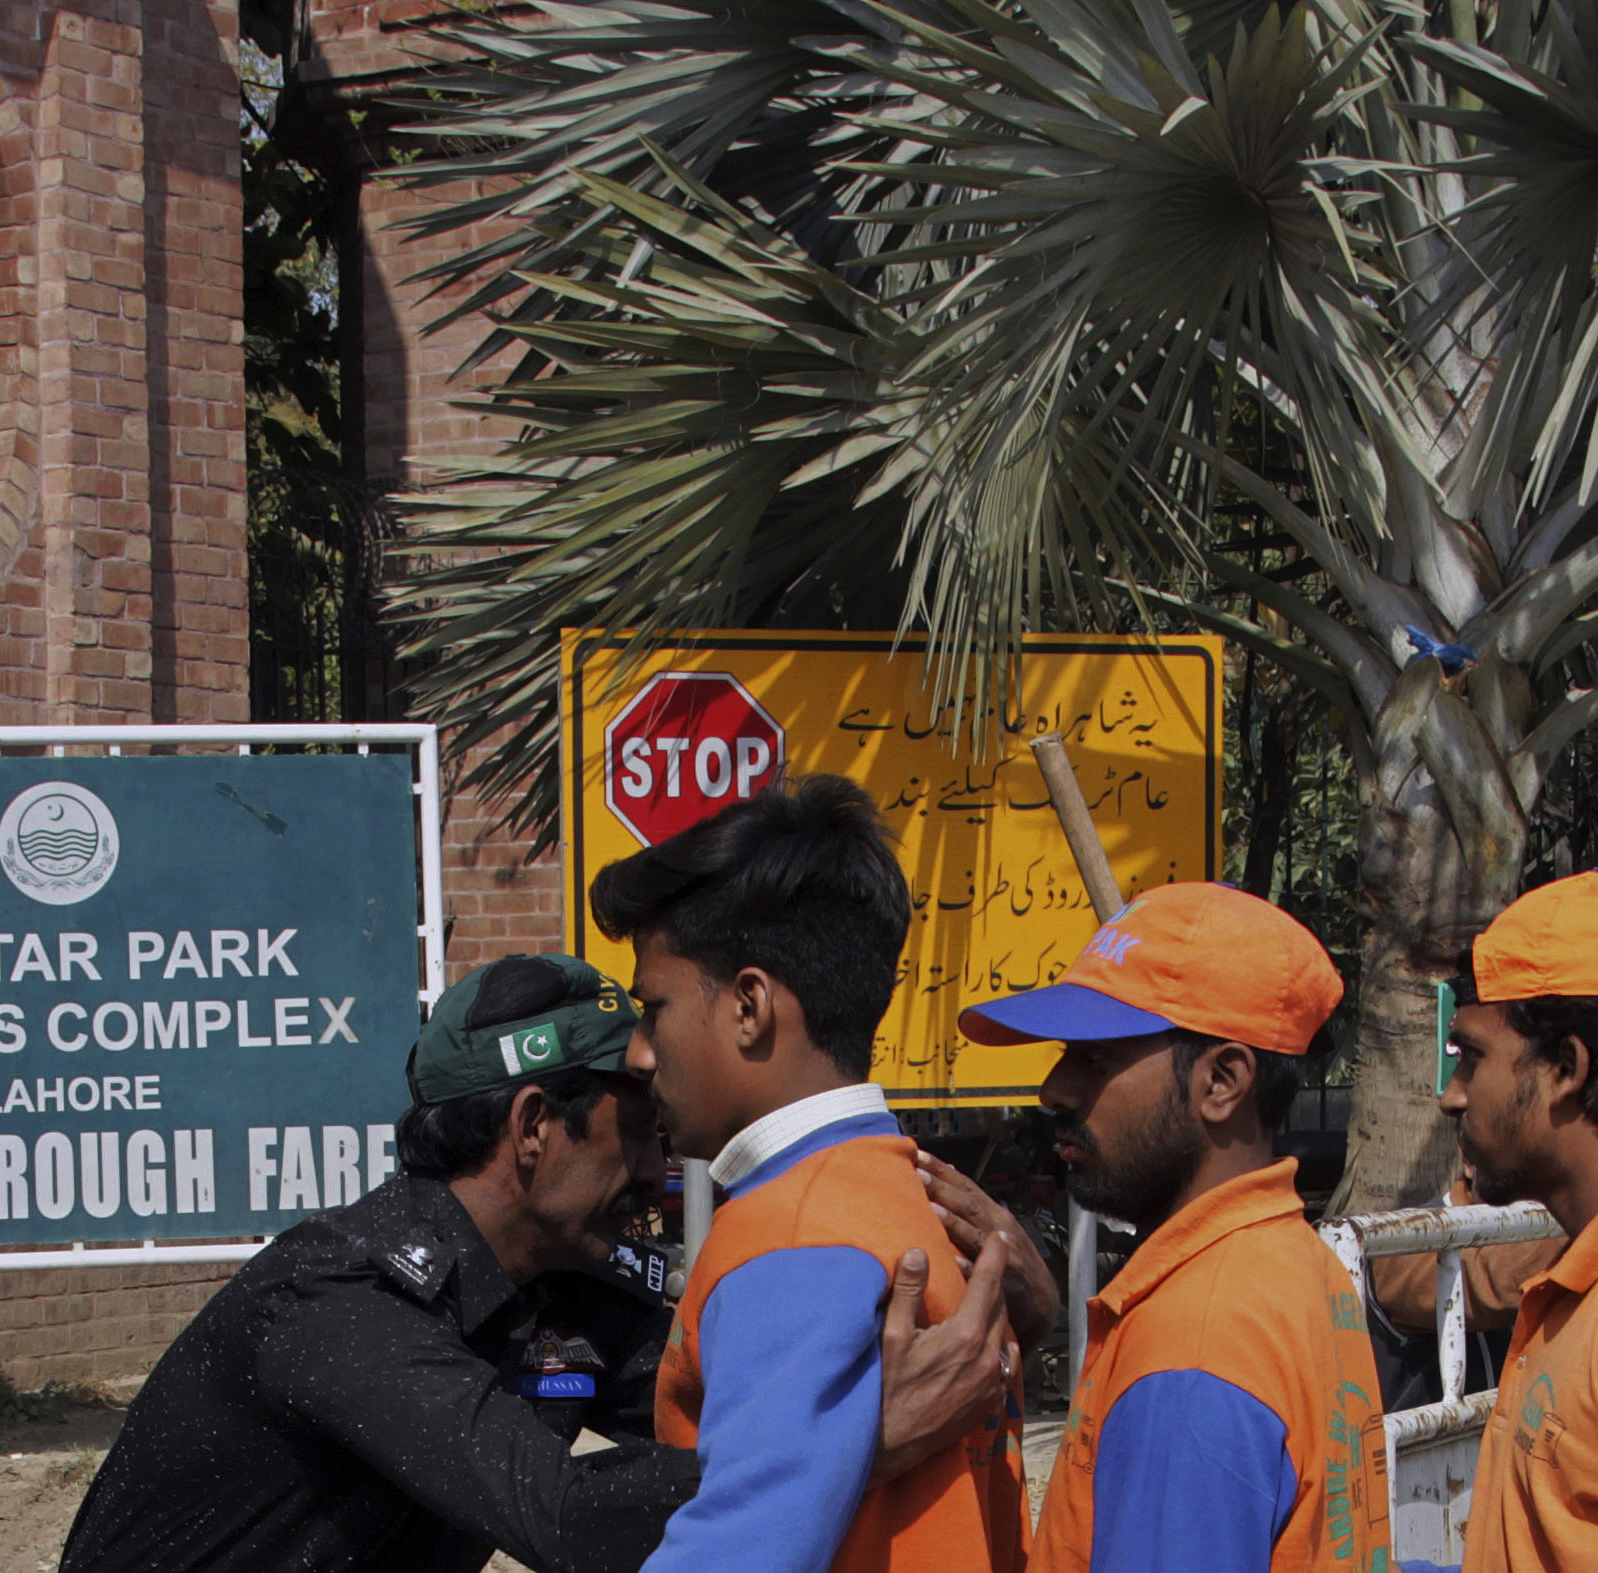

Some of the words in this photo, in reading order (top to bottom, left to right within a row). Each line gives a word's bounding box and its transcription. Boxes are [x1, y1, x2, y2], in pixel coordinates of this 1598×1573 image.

[620, 735, 770, 799] STOP
[128, 928, 299, 980] PARK
[47, 997, 360, 1052] COMPLEX
